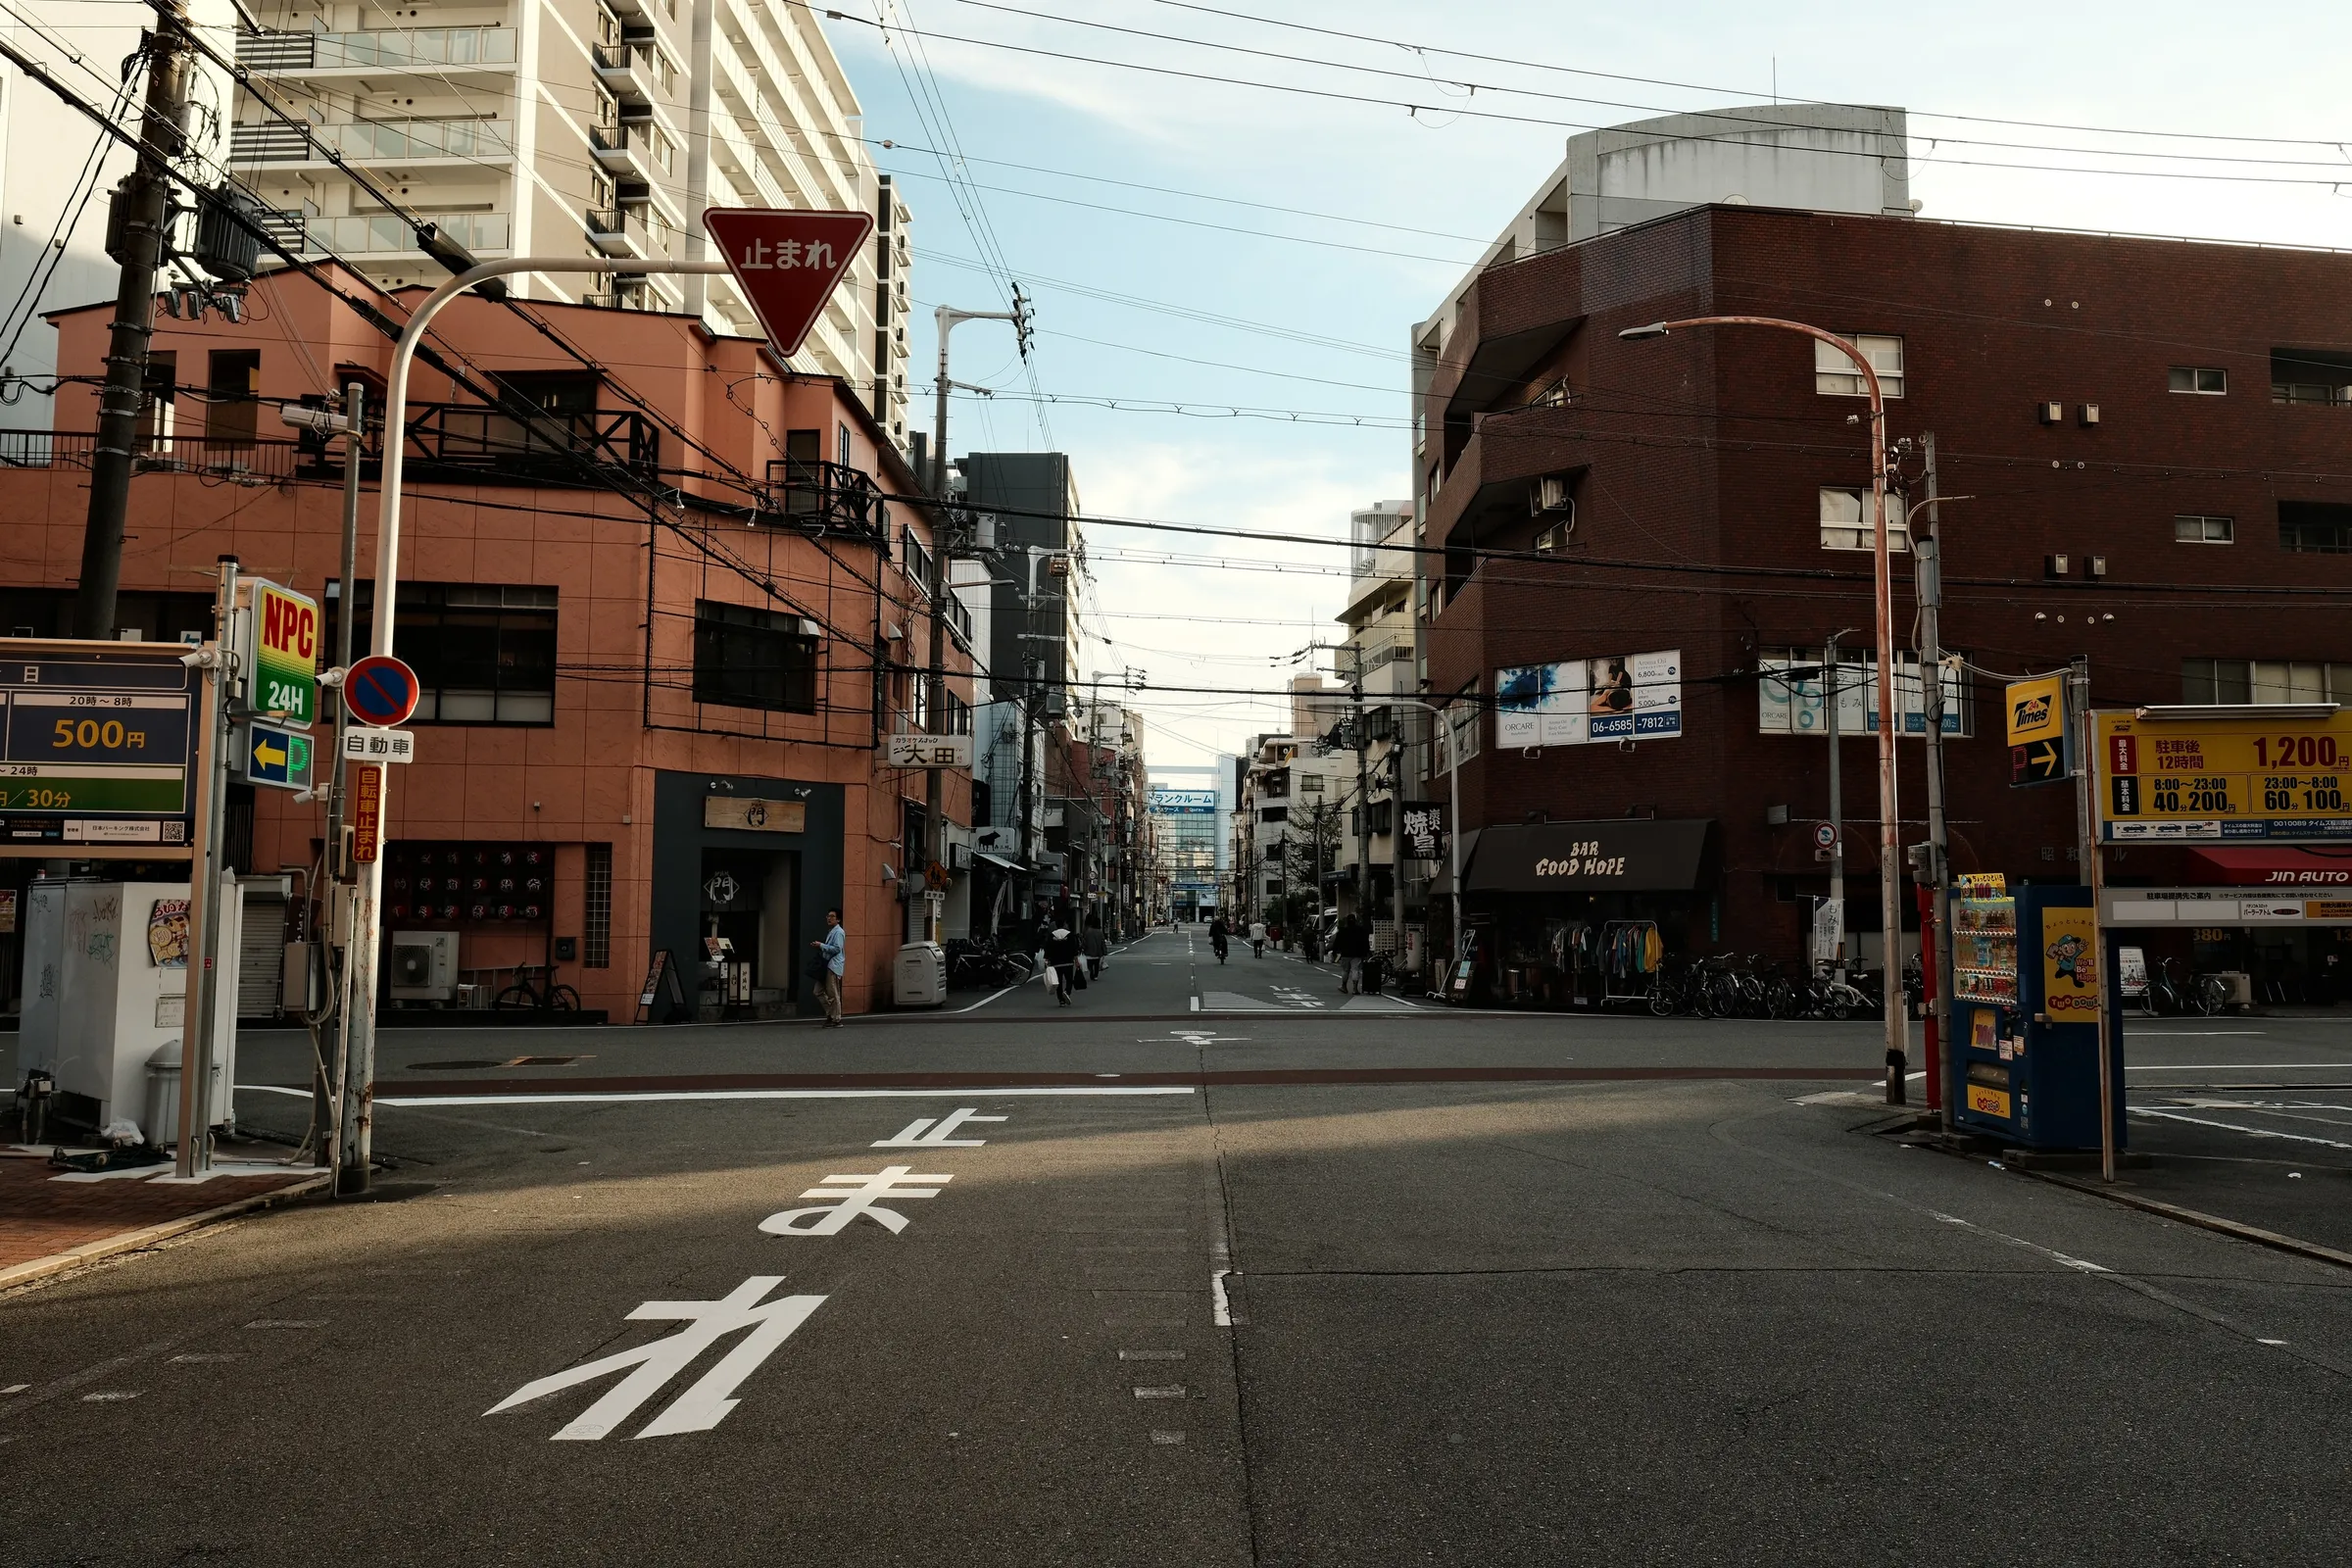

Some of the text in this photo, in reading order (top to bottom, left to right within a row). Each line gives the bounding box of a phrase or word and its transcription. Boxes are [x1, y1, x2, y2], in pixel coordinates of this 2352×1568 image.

[740, 238, 837, 270] 止まれ
[264, 592, 314, 659] NPC
[268, 681, 303, 714] 24H
[1505, 722, 1534, 731] ORCARE
[2016, 707, 2047, 727] Times
[53, 719, 145, 749] 500円
[347, 734, 410, 756] 自動車
[904, 744, 955, 763] 大田
[2118, 739, 2129, 770] 最大料金
[2155, 740, 2200, 754] 駐車後
[287, 737, 308, 784] P
[2157, 756, 2204, 769] 12時間
[2154, 778, 2227, 790] 8:00～23:00
[2265, 777, 2337, 789] 23:00～8:00
[2121, 780, 2131, 811] 基本料金
[357, 770, 377, 859] 自転車止まれ
[748, 807, 765, 826] 門
[1570, 840, 1598, 857] BAR
[1536, 857, 1627, 876] GOOD HOPE
[2265, 871, 2349, 882] JIN AUTO
[710, 876, 734, 901] 門
[481, 1108, 1009, 1441] 止まれ
